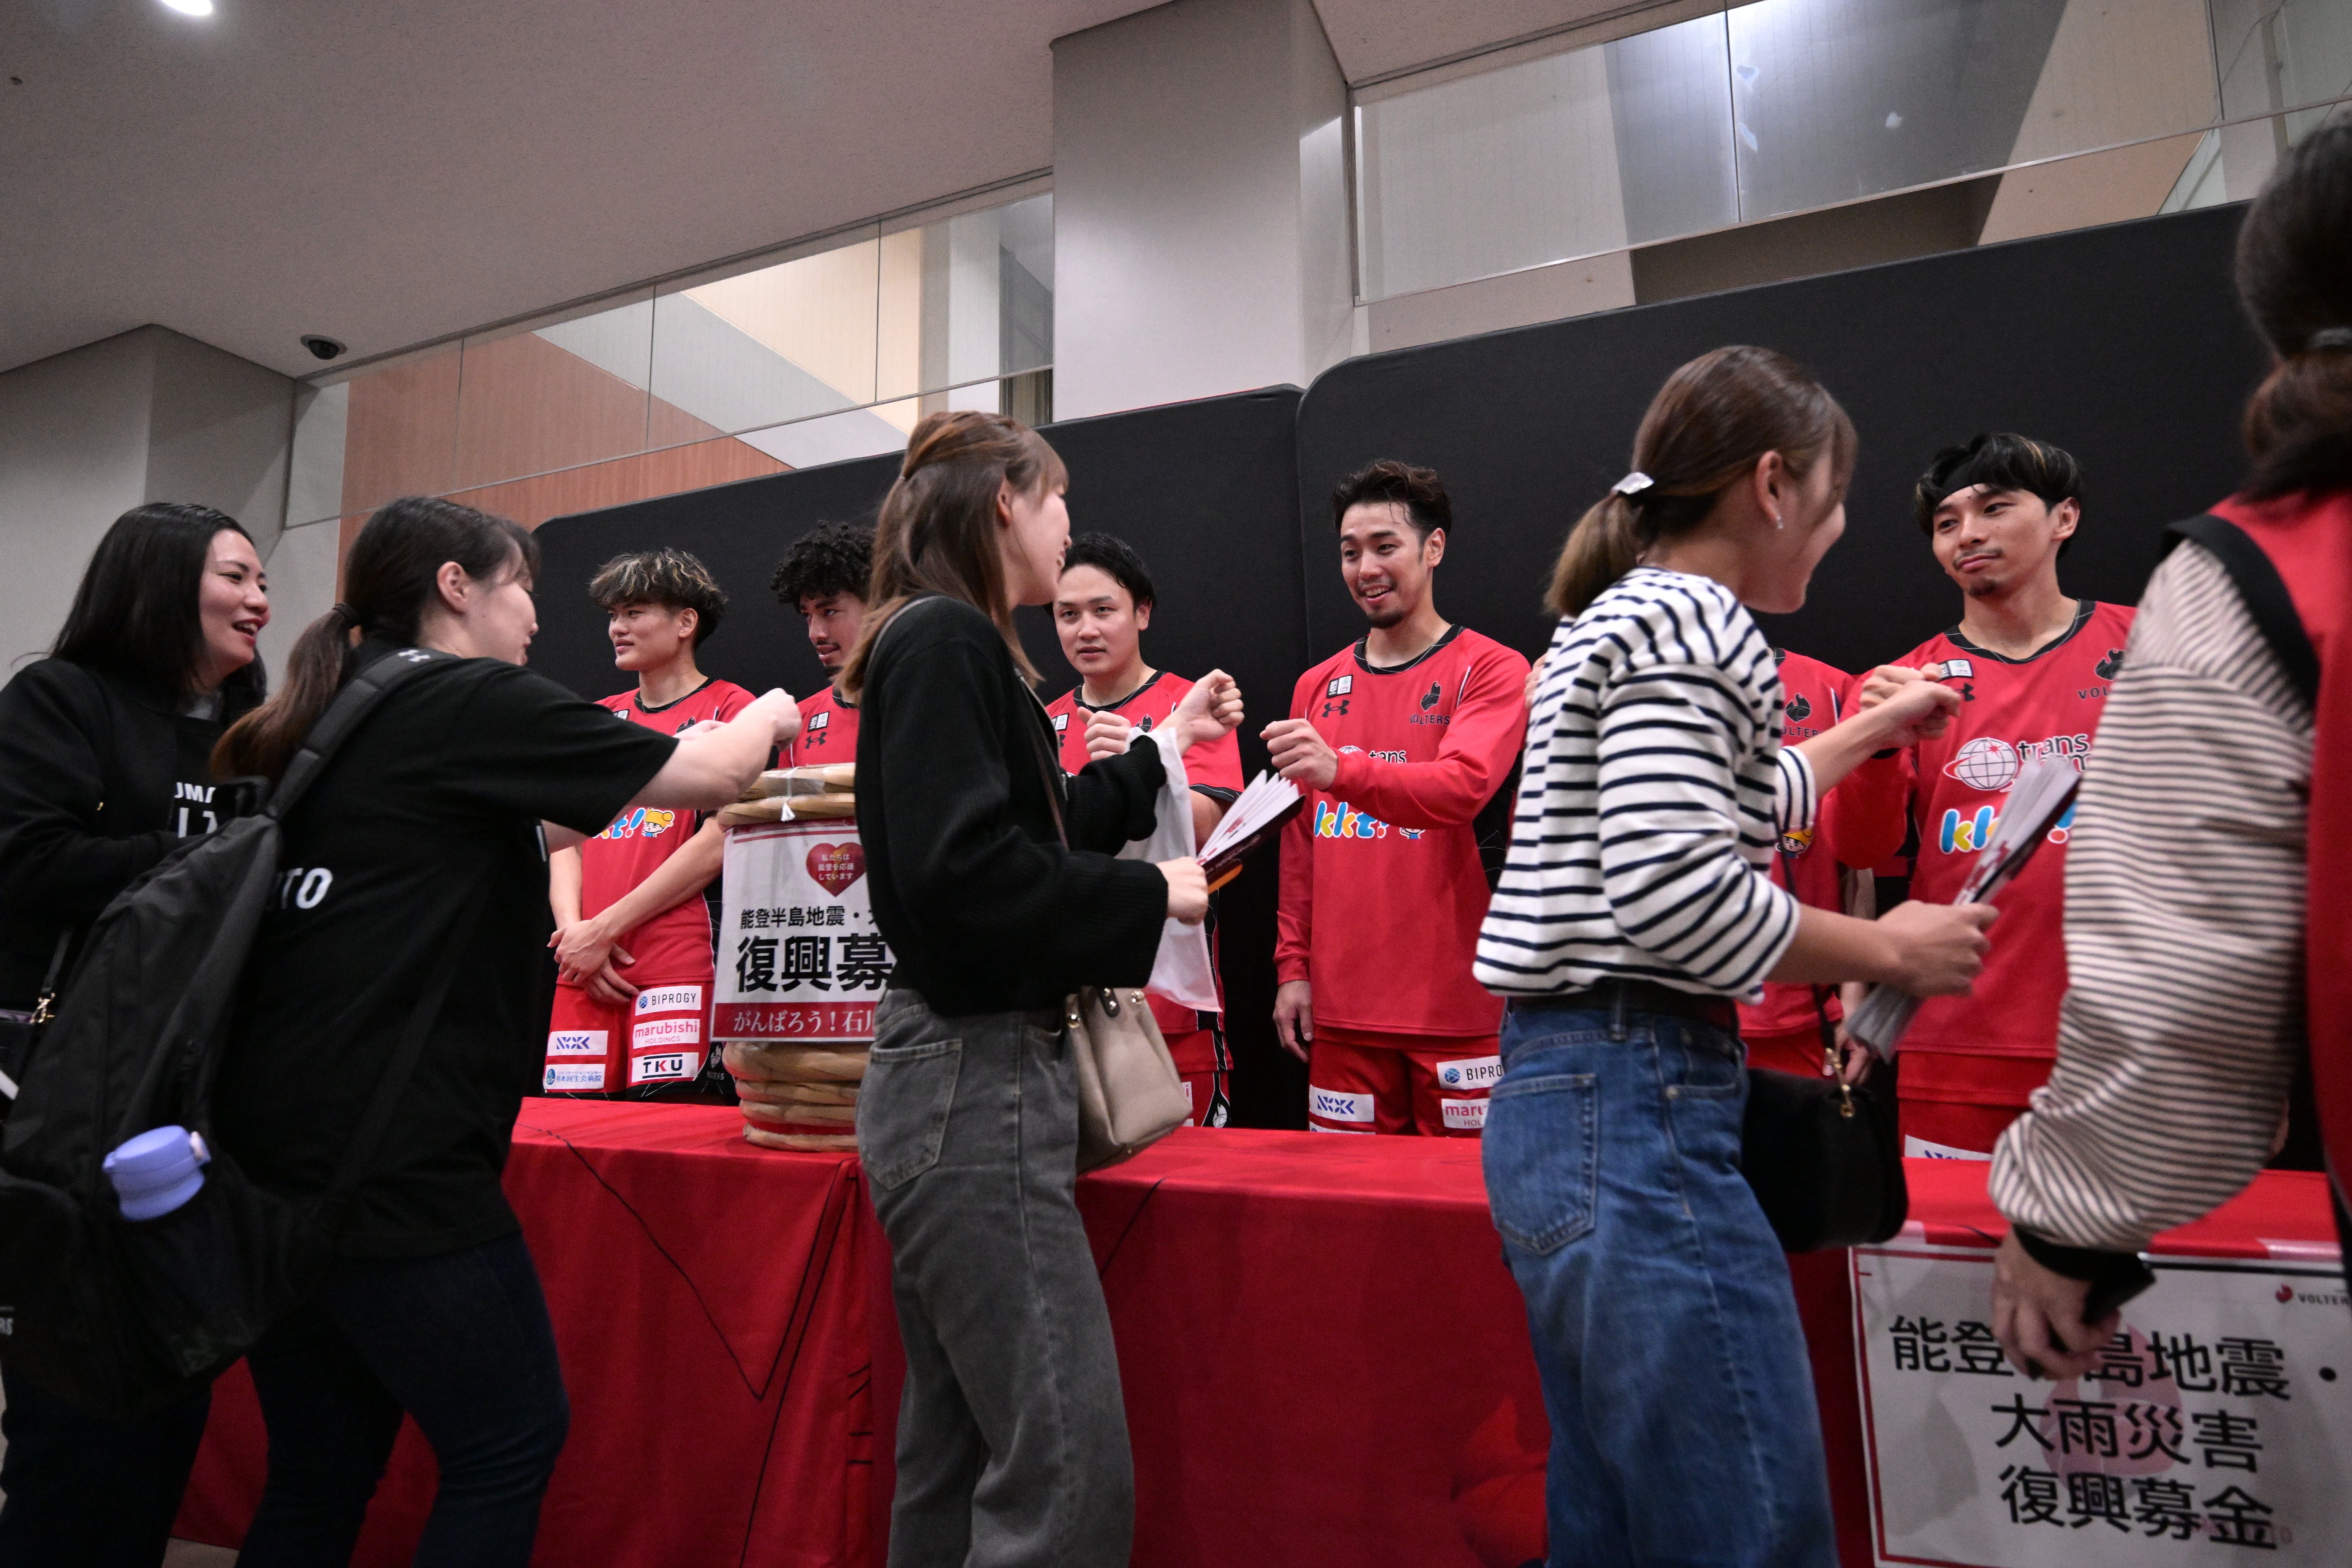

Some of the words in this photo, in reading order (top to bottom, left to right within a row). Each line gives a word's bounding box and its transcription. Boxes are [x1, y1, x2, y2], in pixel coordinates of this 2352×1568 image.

[2017, 734, 2088, 760] trans
[1369, 750, 1407, 763] tans
[652, 993, 696, 1005] BIPROGY
[635, 1021, 697, 1038] marubishi
[645, 1036, 681, 1045] HOLDINGS
[643, 1060, 683, 1073] TKU
[1466, 1064, 1503, 1080] BIPRO
[1889, 1315, 2337, 1401] 能登島地震・
[1992, 1393, 2263, 1473] 大雨災害
[2000, 1464, 2277, 1550] 復興募金
